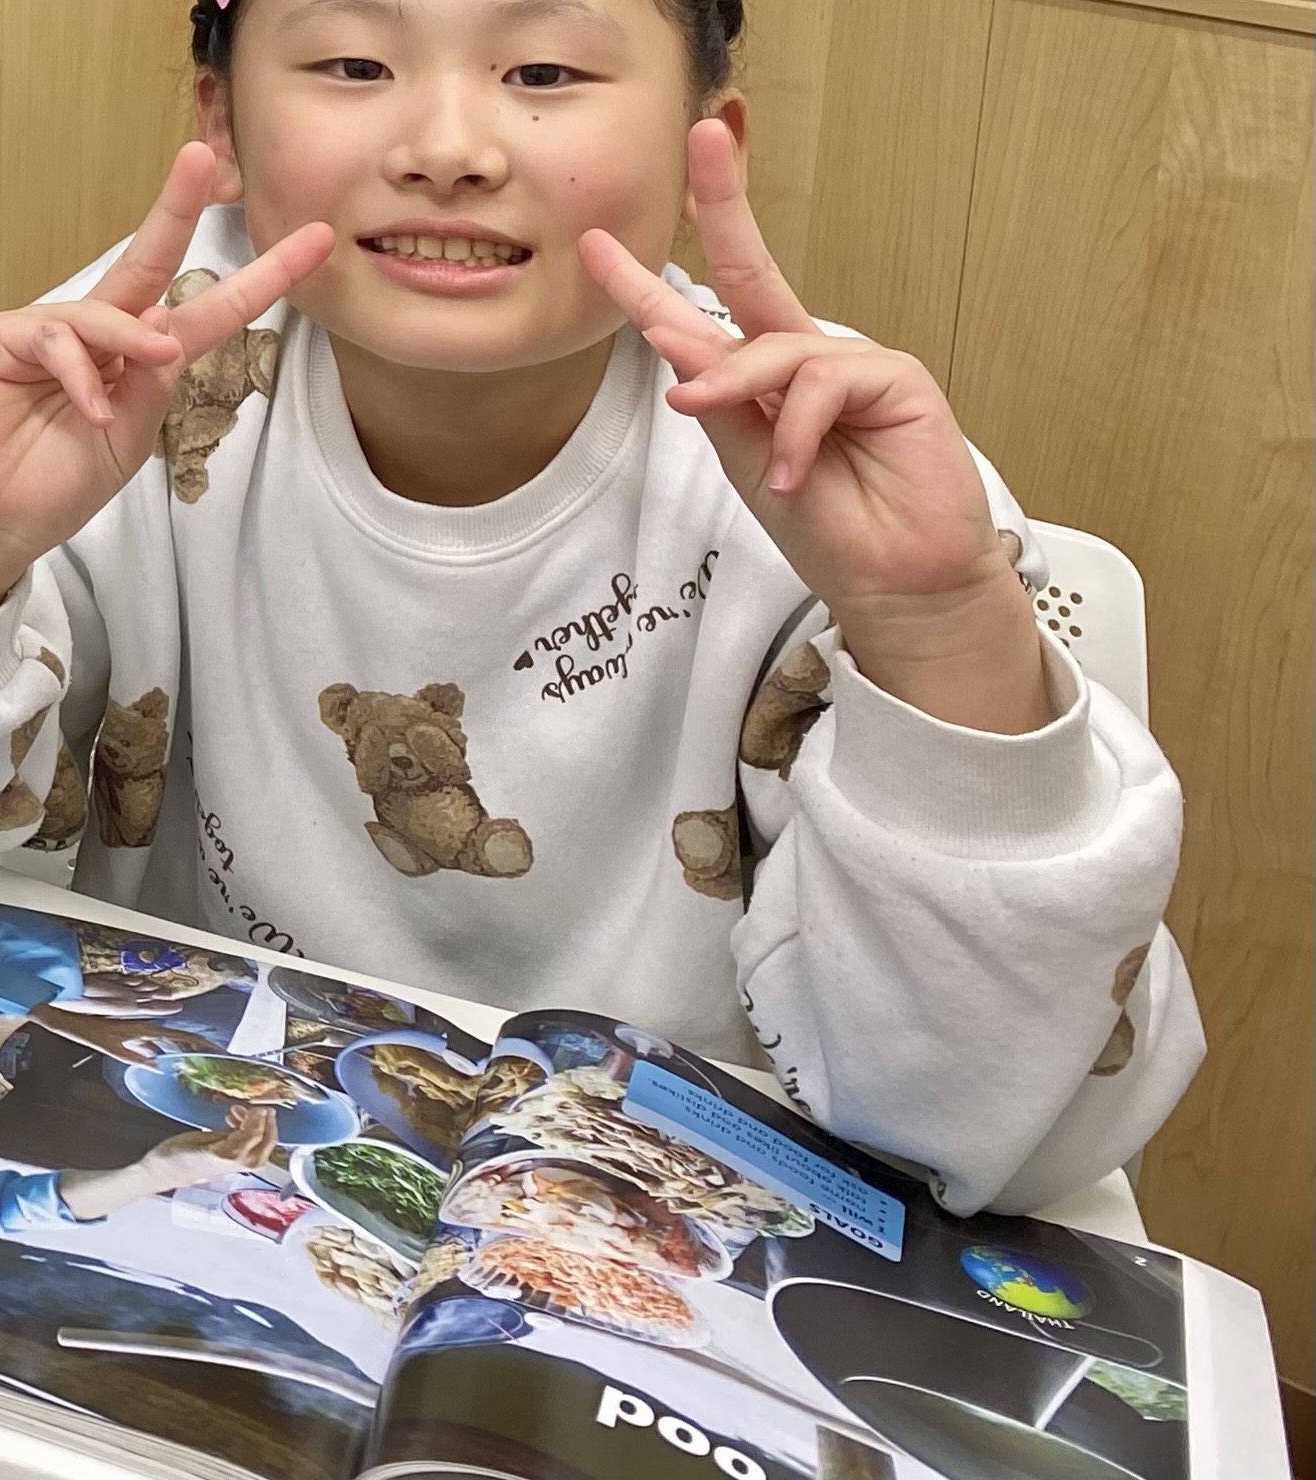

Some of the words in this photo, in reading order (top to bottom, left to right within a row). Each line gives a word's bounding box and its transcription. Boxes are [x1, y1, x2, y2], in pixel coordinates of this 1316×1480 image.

[711, 1111, 741, 1131] and
[737, 1117, 769, 1140] and
[735, 1135, 767, 1155] and
[746, 1131, 780, 1155] likes
[772, 1137, 809, 1162] food
[771, 1155, 815, 1185] foods
[786, 1154, 832, 1183] about
[815, 1163, 836, 1179] for
[809, 1202, 883, 1249] GOALS
[976, 1289, 1076, 1330] THAILAND
[596, 1384, 767, 1480] ood
